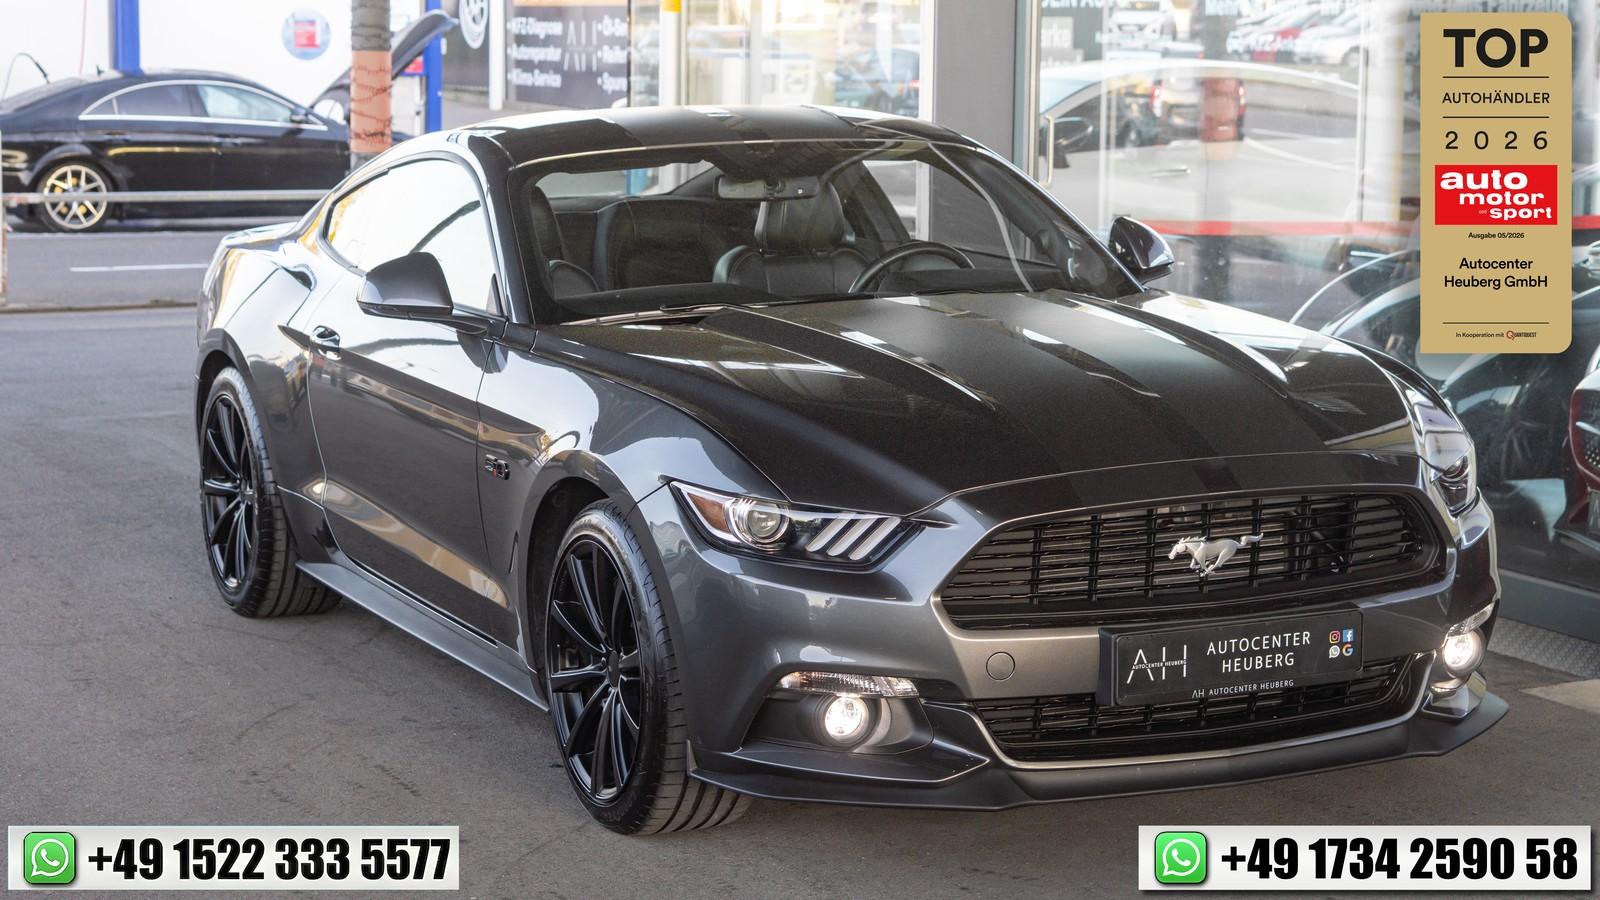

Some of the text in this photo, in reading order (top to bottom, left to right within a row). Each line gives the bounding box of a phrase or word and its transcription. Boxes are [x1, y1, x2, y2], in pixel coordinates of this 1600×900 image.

[1206, 631, 1312, 656] AUTOCENTER
[1126, 644, 1187, 684] AH
[1222, 652, 1295, 674] HEUBERG
[1208, 684, 1258, 696] AUTOCENTER
[1260, 679, 1294, 690] HEUBERG
